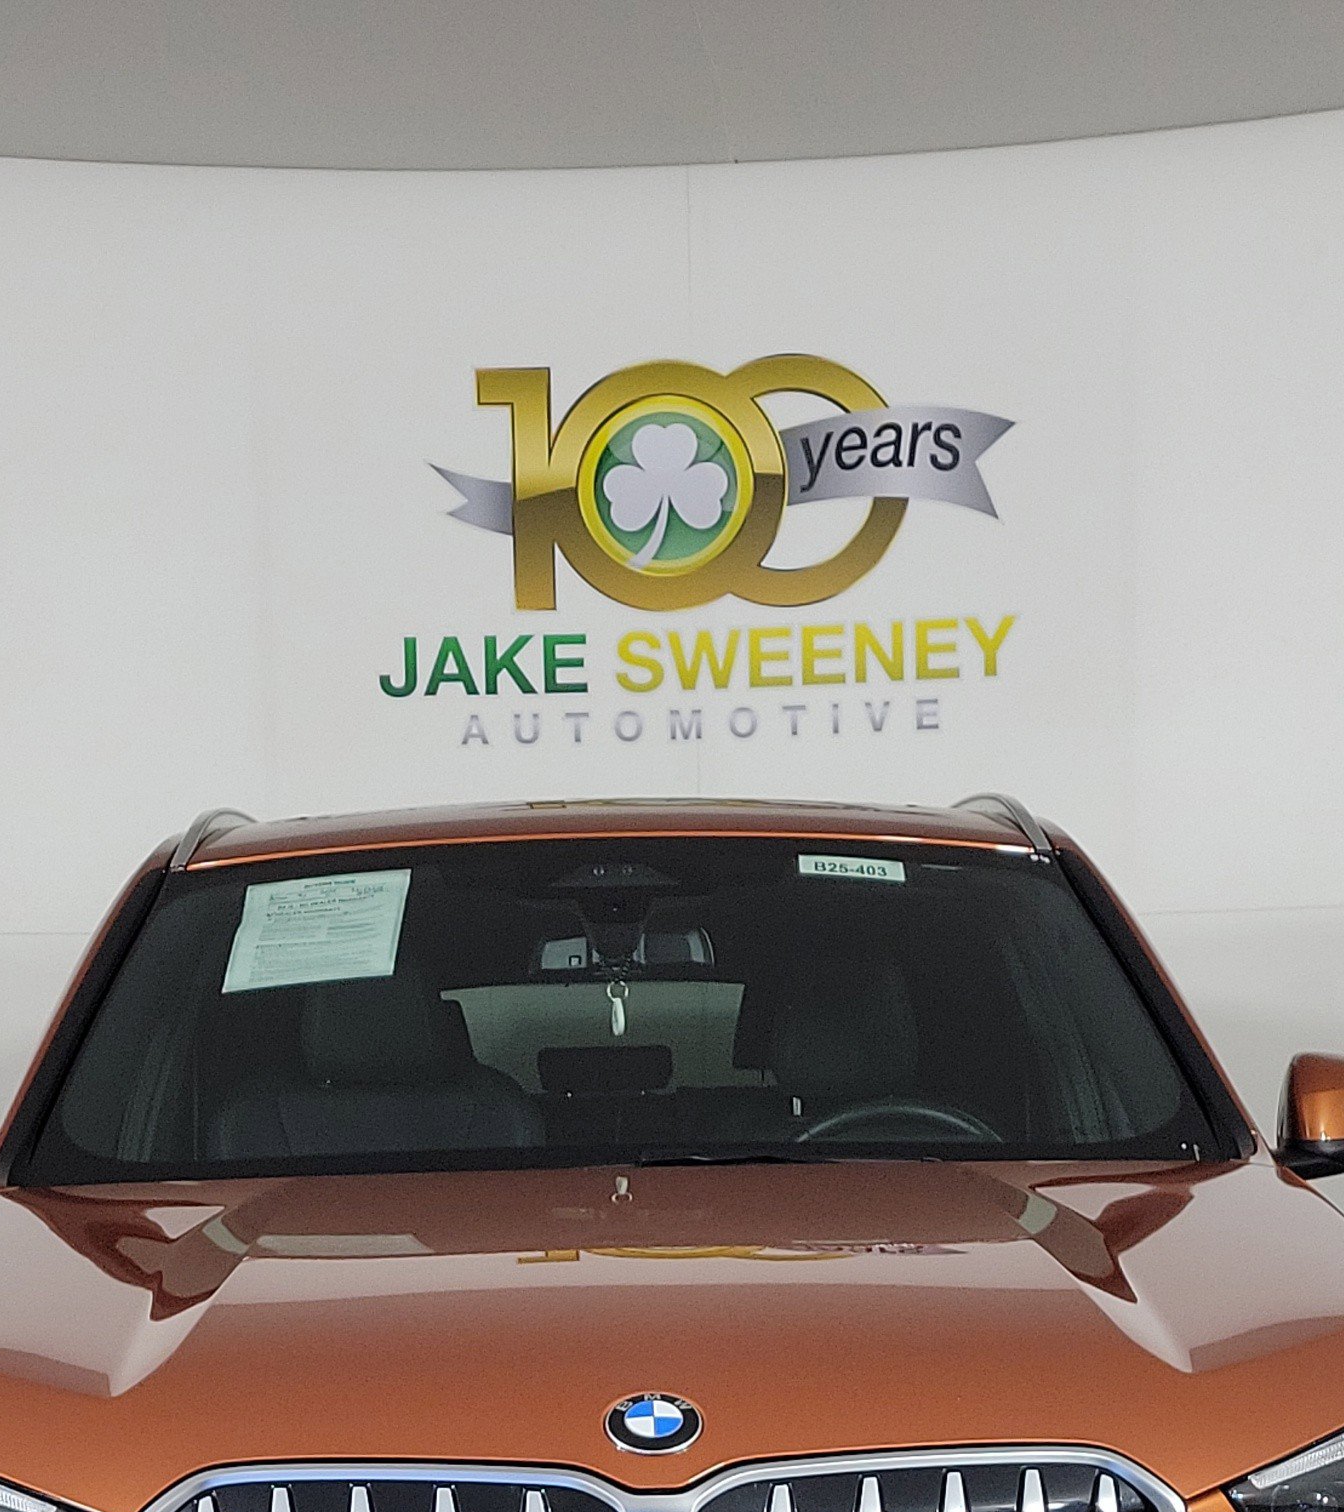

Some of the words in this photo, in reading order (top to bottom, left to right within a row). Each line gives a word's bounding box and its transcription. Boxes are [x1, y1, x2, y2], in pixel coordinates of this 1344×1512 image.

[475, 353, 908, 611] 100
[799, 420, 962, 493] years
[379, 633, 588, 698] JAKE
[615, 615, 1016, 692] SWEENEY
[461, 699, 941, 746] AUTOMOTIVE
[814, 861, 887, 877] B25-403
[616, 1394, 692, 1411] BMW
